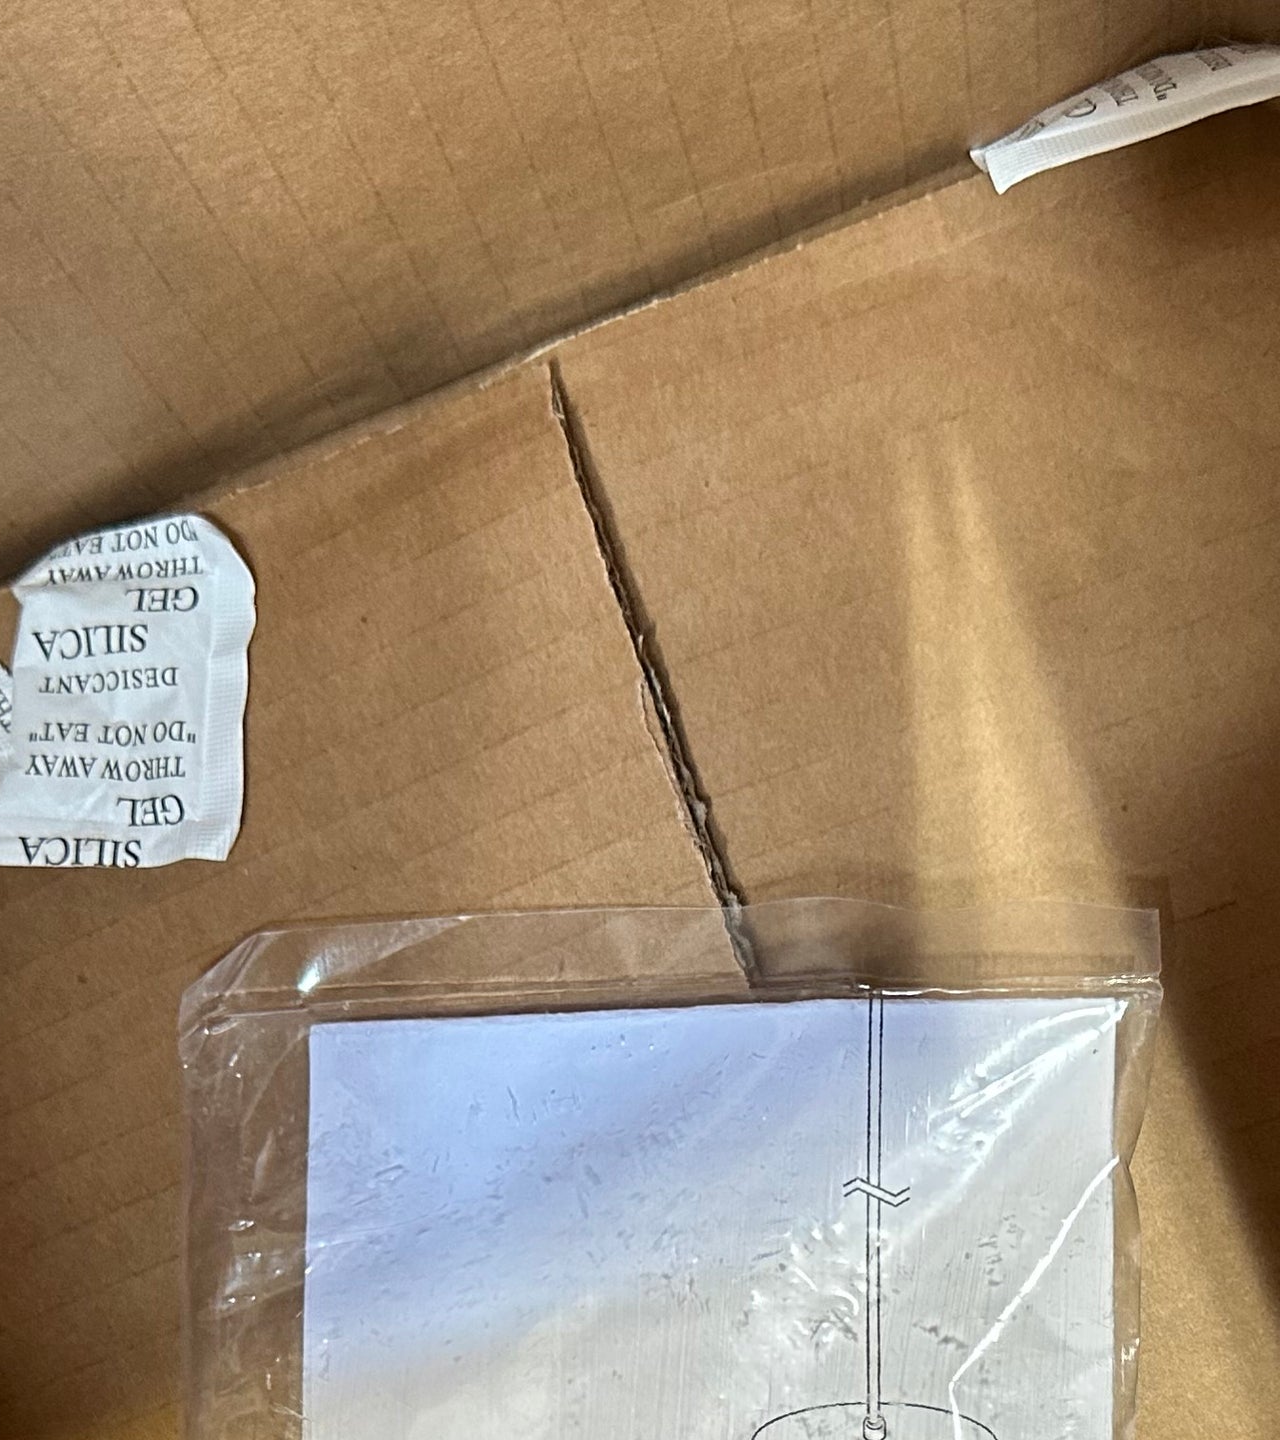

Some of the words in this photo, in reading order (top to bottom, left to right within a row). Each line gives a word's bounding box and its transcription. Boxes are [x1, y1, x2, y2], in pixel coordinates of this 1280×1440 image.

[112, 528, 158, 552] NOT
[46, 565, 112, 585] AWAY
[113, 557, 203, 581] THROW
[125, 586, 199, 612] GEL
[31, 624, 148, 661] SILICA
[38, 667, 178, 693] DESICCANT
[29, 722, 89, 743] EAT"
[98, 725, 147, 747] NOT
[153, 721, 196, 745] "DO
[25, 755, 98, 777] AWAY
[100, 757, 185, 782] THROW
[116, 795, 184, 827] GEL
[18, 837, 141, 868] SILICA
